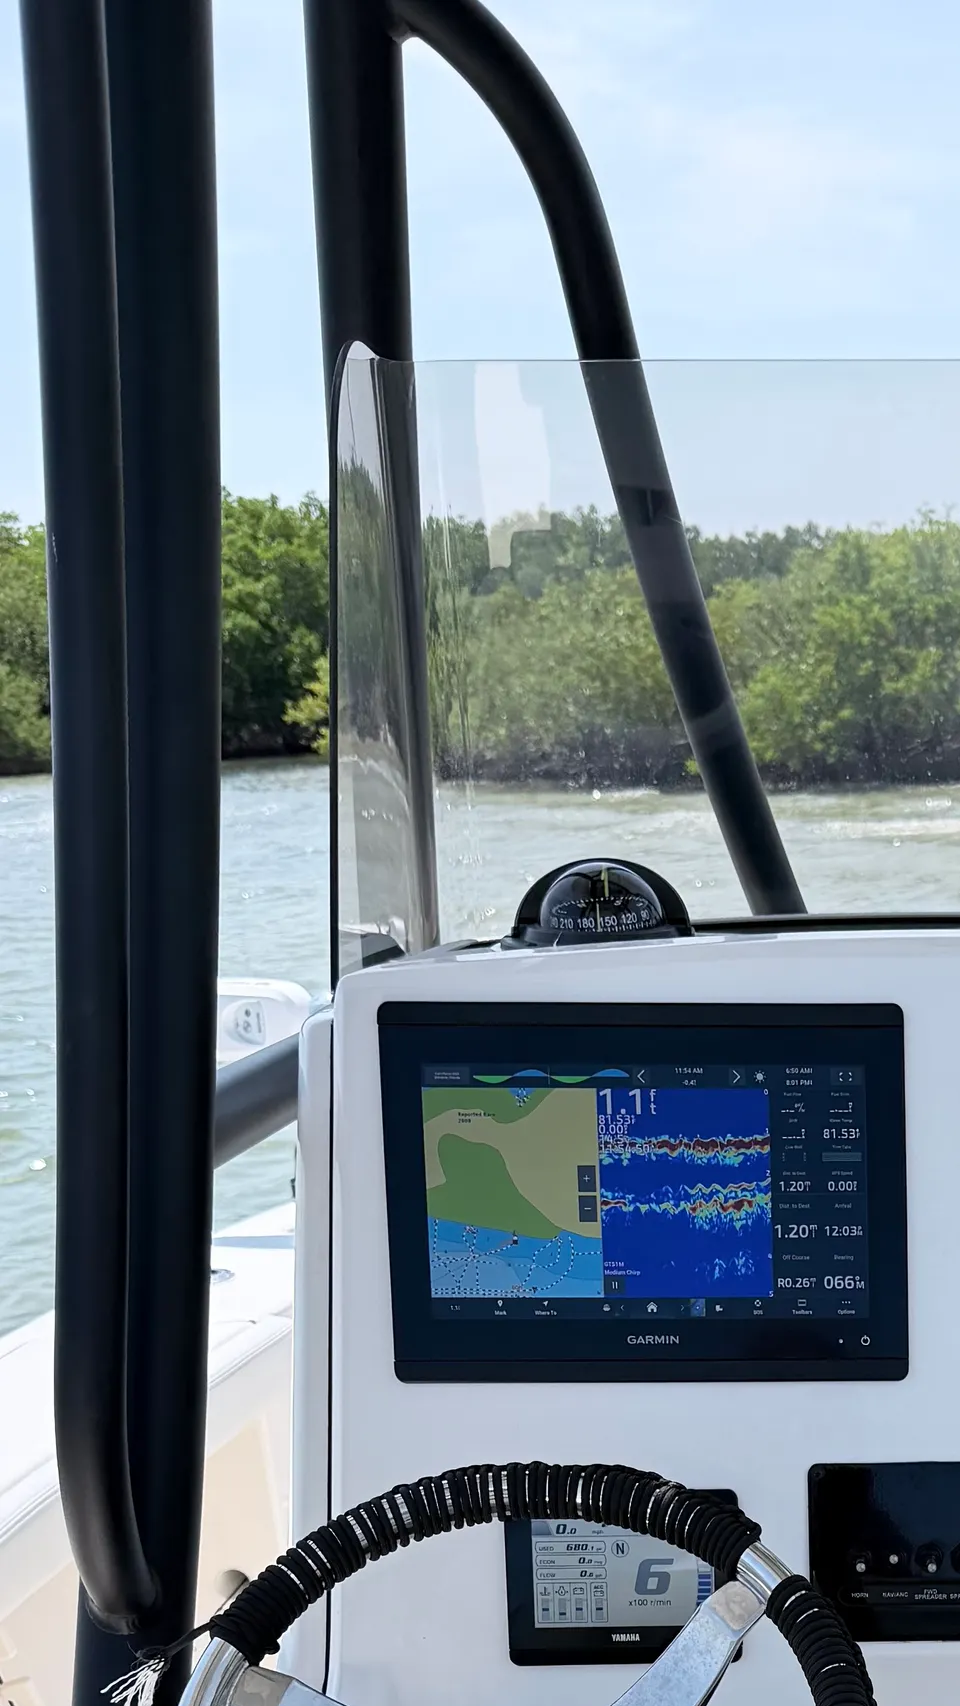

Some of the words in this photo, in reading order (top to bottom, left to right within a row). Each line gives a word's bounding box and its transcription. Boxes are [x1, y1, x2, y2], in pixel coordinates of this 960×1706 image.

[560, 918, 574, 929] 210
[577, 918, 595, 928] 180
[600, 916, 617, 927] 150
[621, 913, 637, 924] 120
[599, 1088, 642, 1114] 1.1
[627, 1335, 680, 1345] GARMIN
[556, 1524, 577, 1535] 0.0
[616, 1543, 625, 1554] N
[634, 1558, 674, 1595] 6
[611, 1634, 640, 1642] YAMAHA
